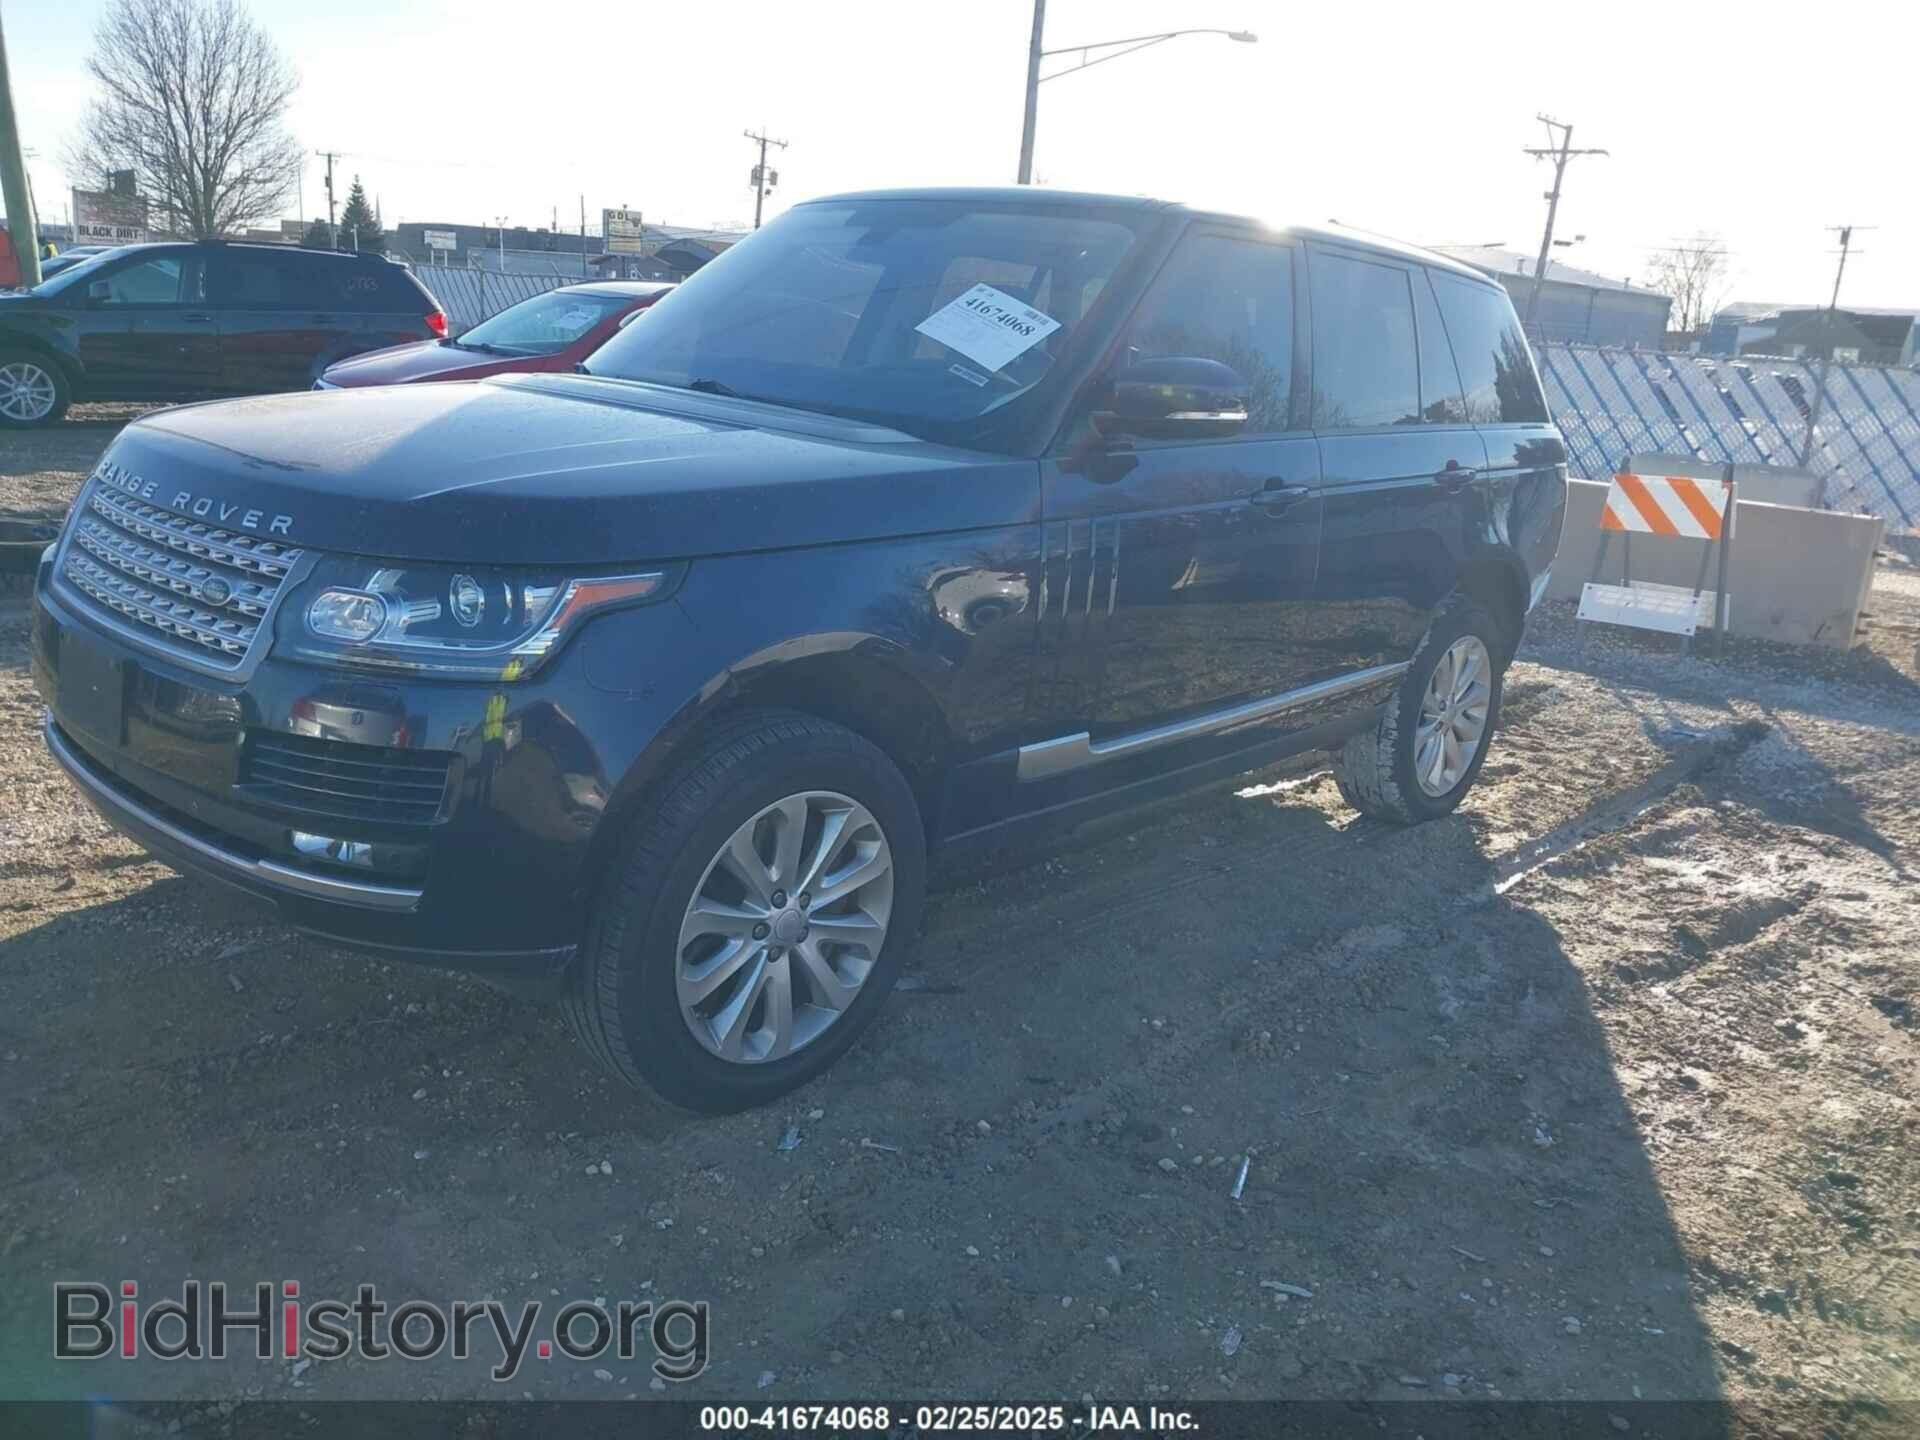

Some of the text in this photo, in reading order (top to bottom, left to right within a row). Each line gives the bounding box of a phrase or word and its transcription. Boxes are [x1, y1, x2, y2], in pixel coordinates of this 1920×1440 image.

[79, 225, 113, 238] BLACK
[965, 299, 1036, 337] 41674068
[99, 459, 295, 535] RANGE ROVER
